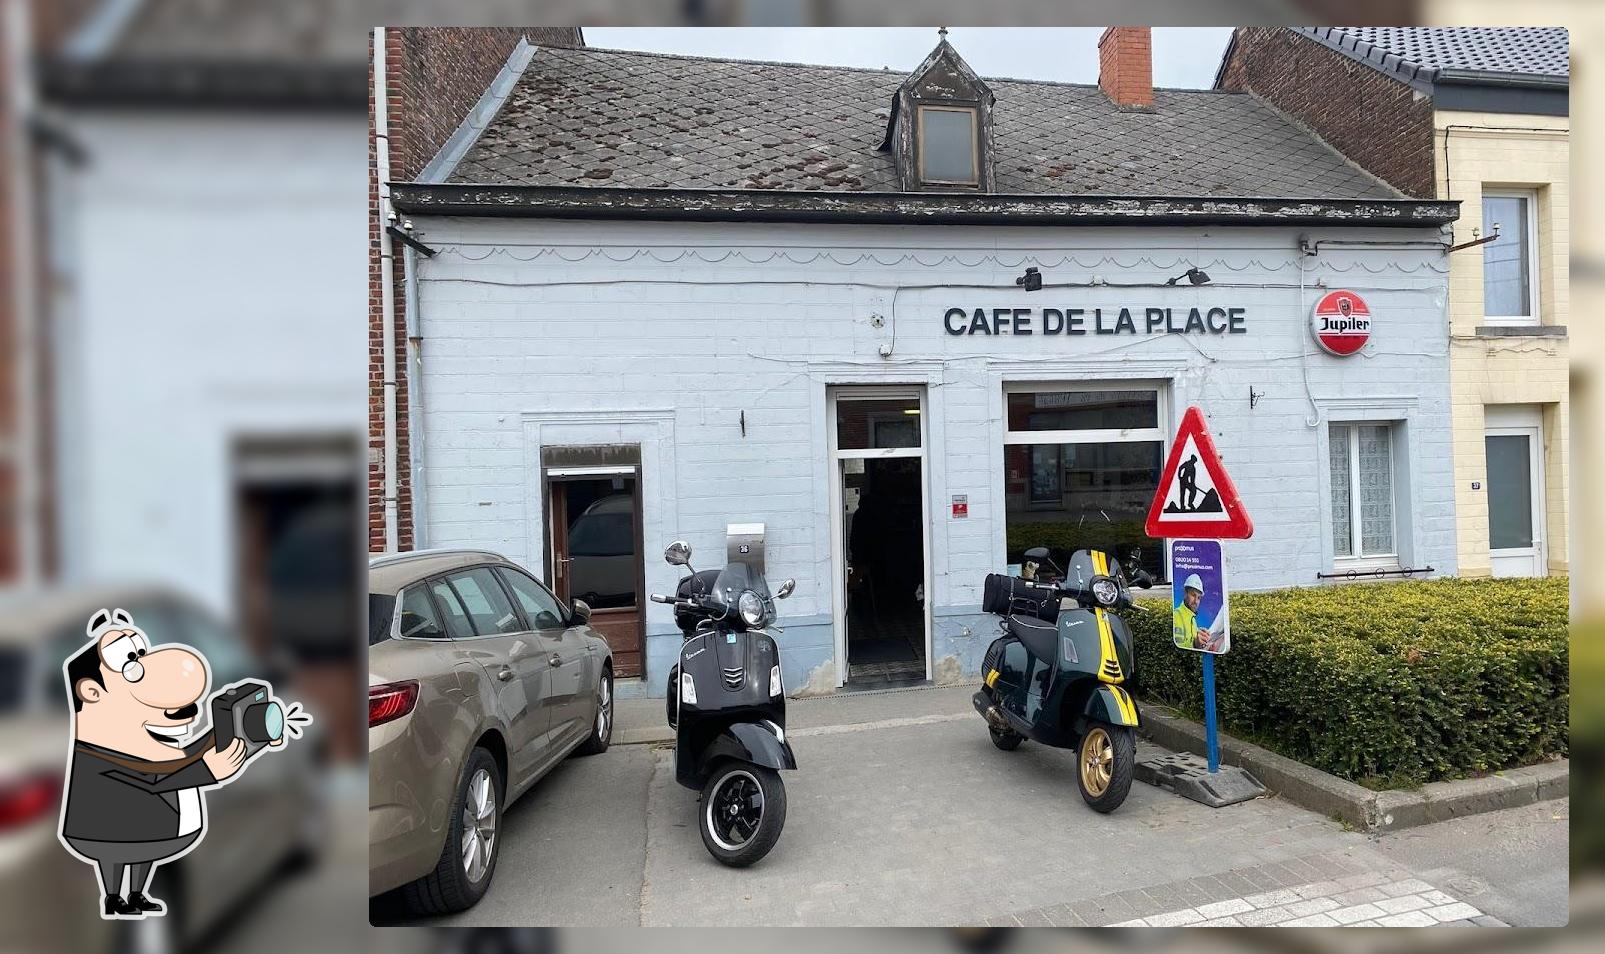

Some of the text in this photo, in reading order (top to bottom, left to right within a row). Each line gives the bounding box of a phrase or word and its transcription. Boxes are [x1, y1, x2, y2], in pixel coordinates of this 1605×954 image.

[944, 307, 1247, 336] CAFE DE LA PLACE
[1320, 317, 1370, 333] Jupiler
